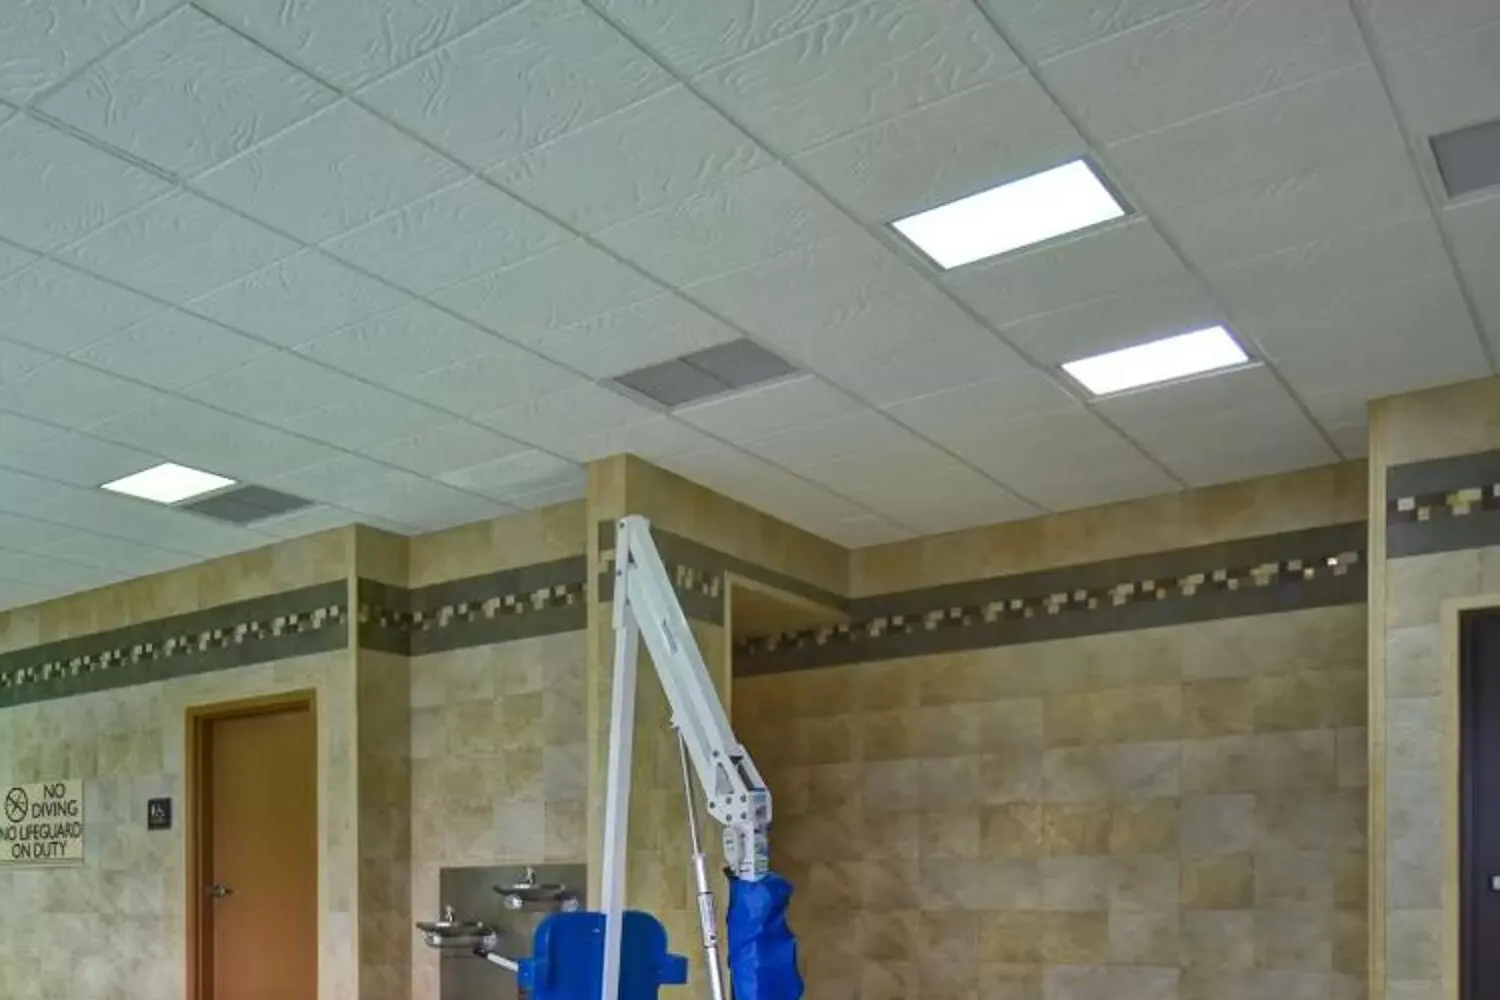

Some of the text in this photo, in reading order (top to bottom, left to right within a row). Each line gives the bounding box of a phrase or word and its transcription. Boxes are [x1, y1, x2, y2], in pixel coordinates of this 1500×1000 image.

[43, 783, 66, 799] NO
[32, 799, 78, 818] DIVING
[0, 821, 82, 841] NO LIFEGUARD
[11, 840, 67, 859] ON DUTY
